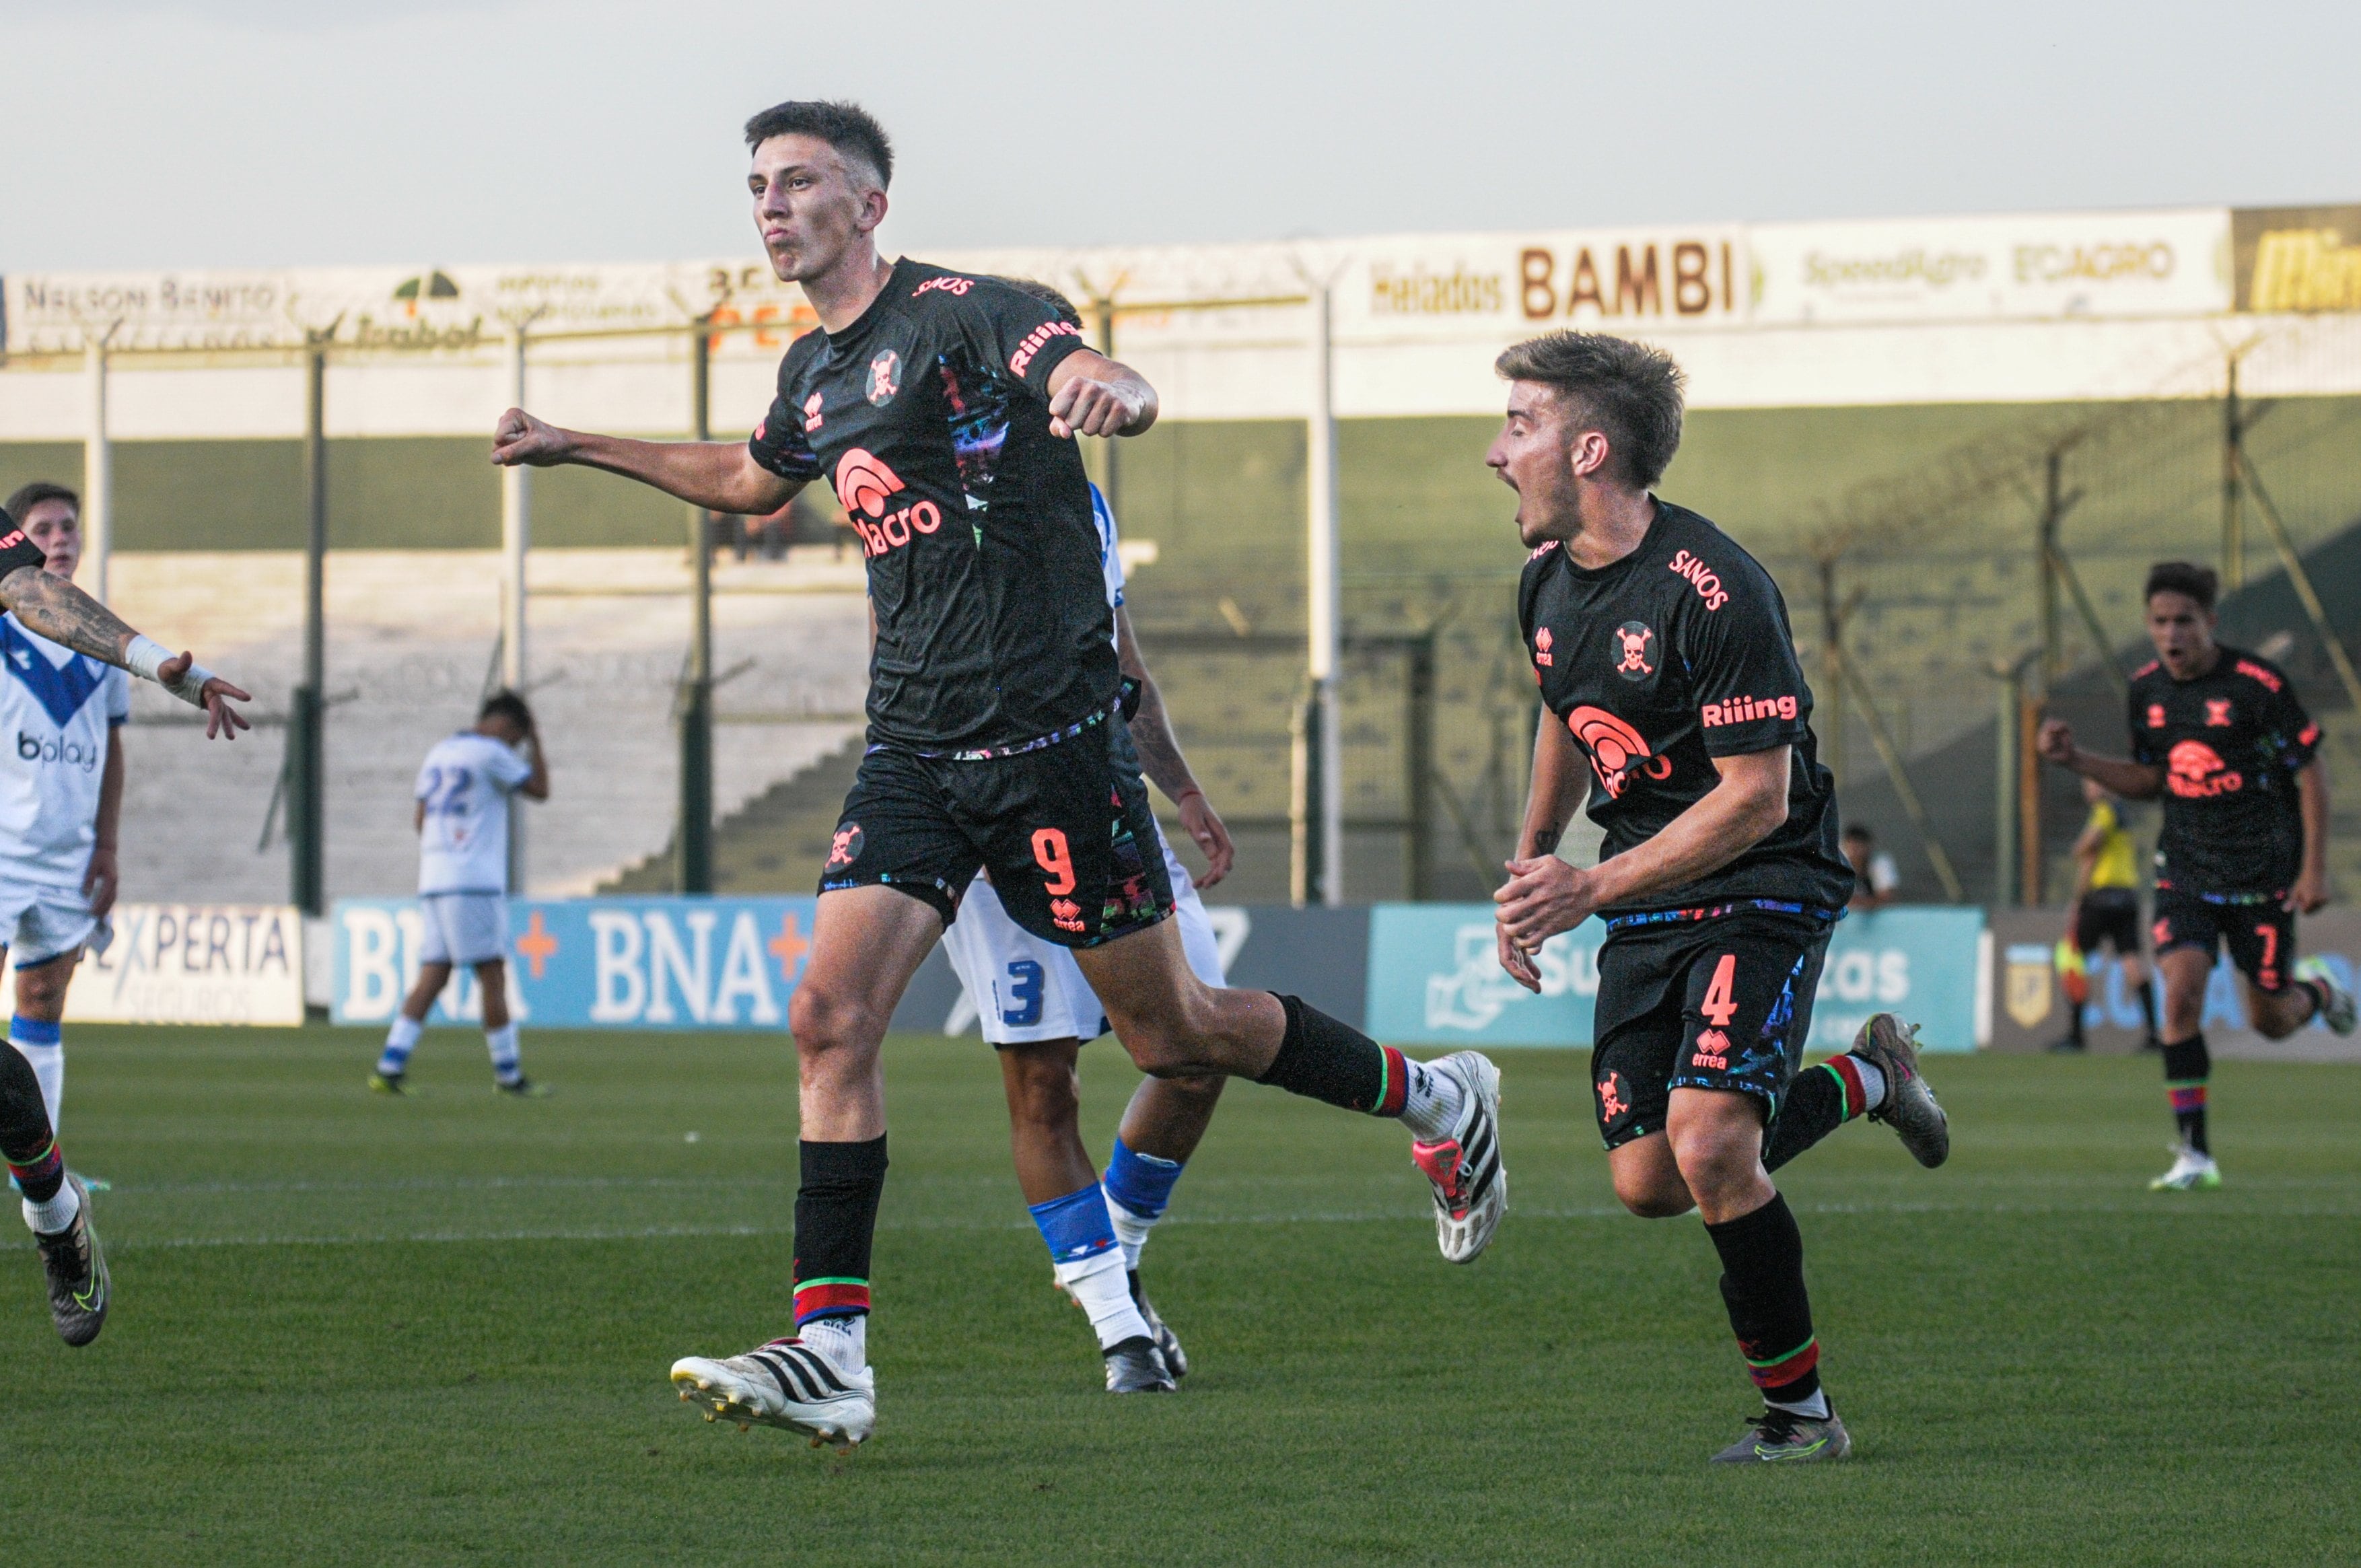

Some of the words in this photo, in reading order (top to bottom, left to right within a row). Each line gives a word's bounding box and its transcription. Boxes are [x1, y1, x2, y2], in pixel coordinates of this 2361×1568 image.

[24, 281, 147, 311] NELSON
[162, 276, 274, 311] BENITO
[1519, 241, 1734, 320] BAMBI
[1010, 321, 1078, 378] Riiing
[1668, 549, 1729, 612] SANOS
[1701, 694, 1797, 728] Riiing
[1031, 828, 1076, 896] 9
[2255, 923, 2280, 966] 7
[1700, 954, 1738, 1026] 4
[1692, 1052, 1728, 1070] errea
